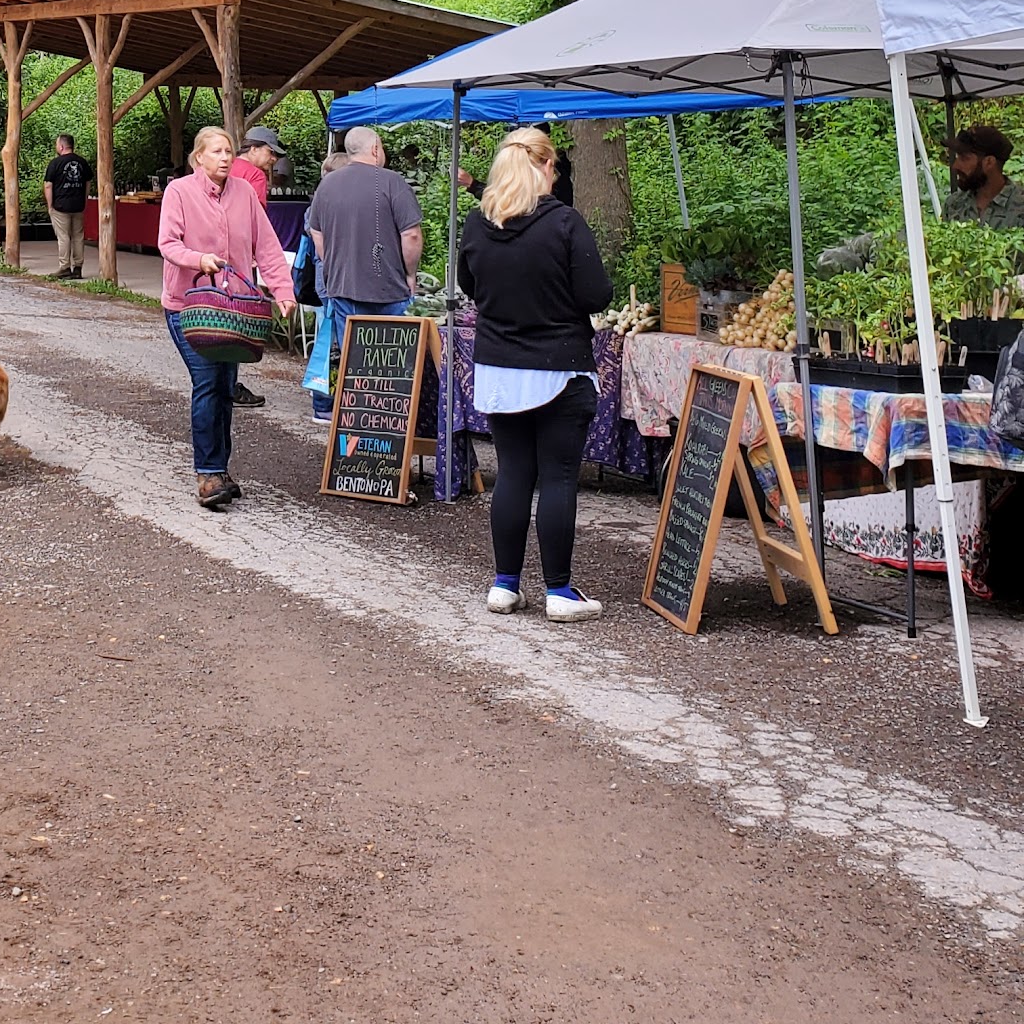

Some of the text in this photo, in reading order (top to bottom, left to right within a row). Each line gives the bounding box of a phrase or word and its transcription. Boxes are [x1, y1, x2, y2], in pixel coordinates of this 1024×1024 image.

[356, 327, 417, 346] ROLLING
[363, 348, 407, 368] RAVEN
[354, 378, 395, 391] NO TILL
[341, 391, 410, 415] NO TRACTOR
[341, 413, 355, 427] NO
[339, 433, 392, 457] VETERAN
[333, 458, 373, 479] Locally
[680, 459, 694, 479] KALE
